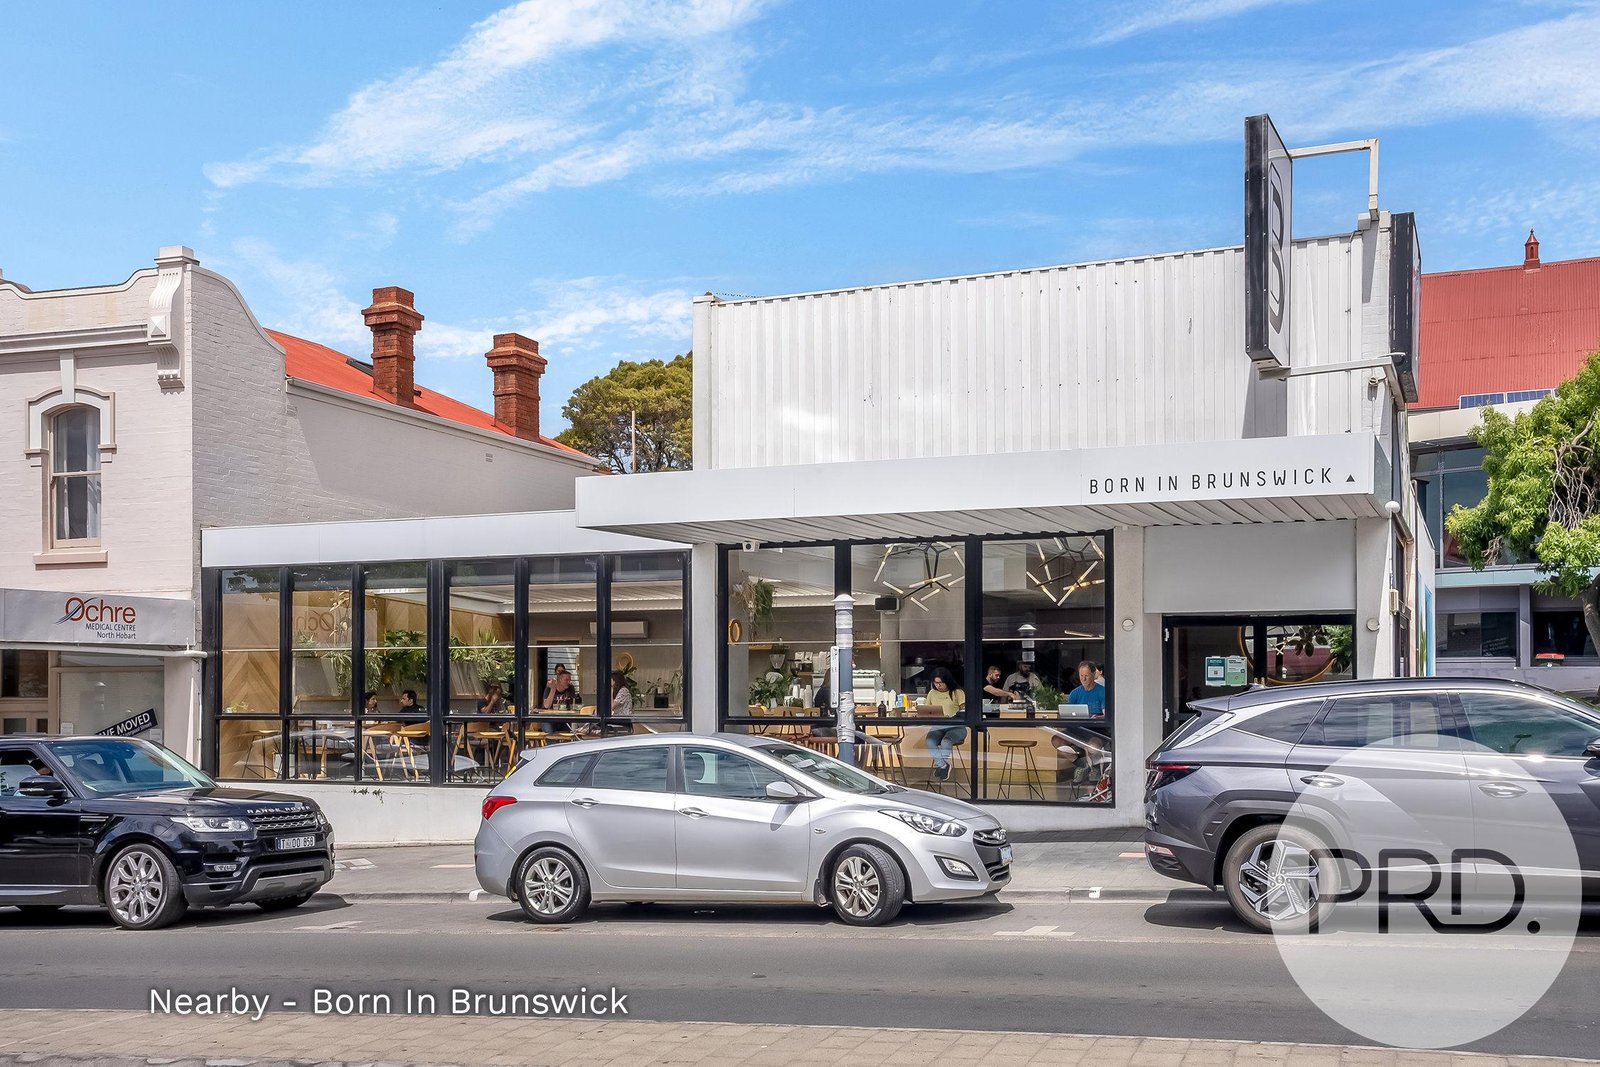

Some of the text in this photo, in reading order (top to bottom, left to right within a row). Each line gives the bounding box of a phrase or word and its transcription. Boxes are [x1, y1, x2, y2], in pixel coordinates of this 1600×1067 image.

[1089, 467, 1332, 495] BORN IN BRUNSWICK
[64, 596, 136, 624] Ochre
[85, 623, 136, 632] MEDICAL CENTRE
[97, 631, 136, 640] North Hobart
[116, 712, 150, 735] MOVED
